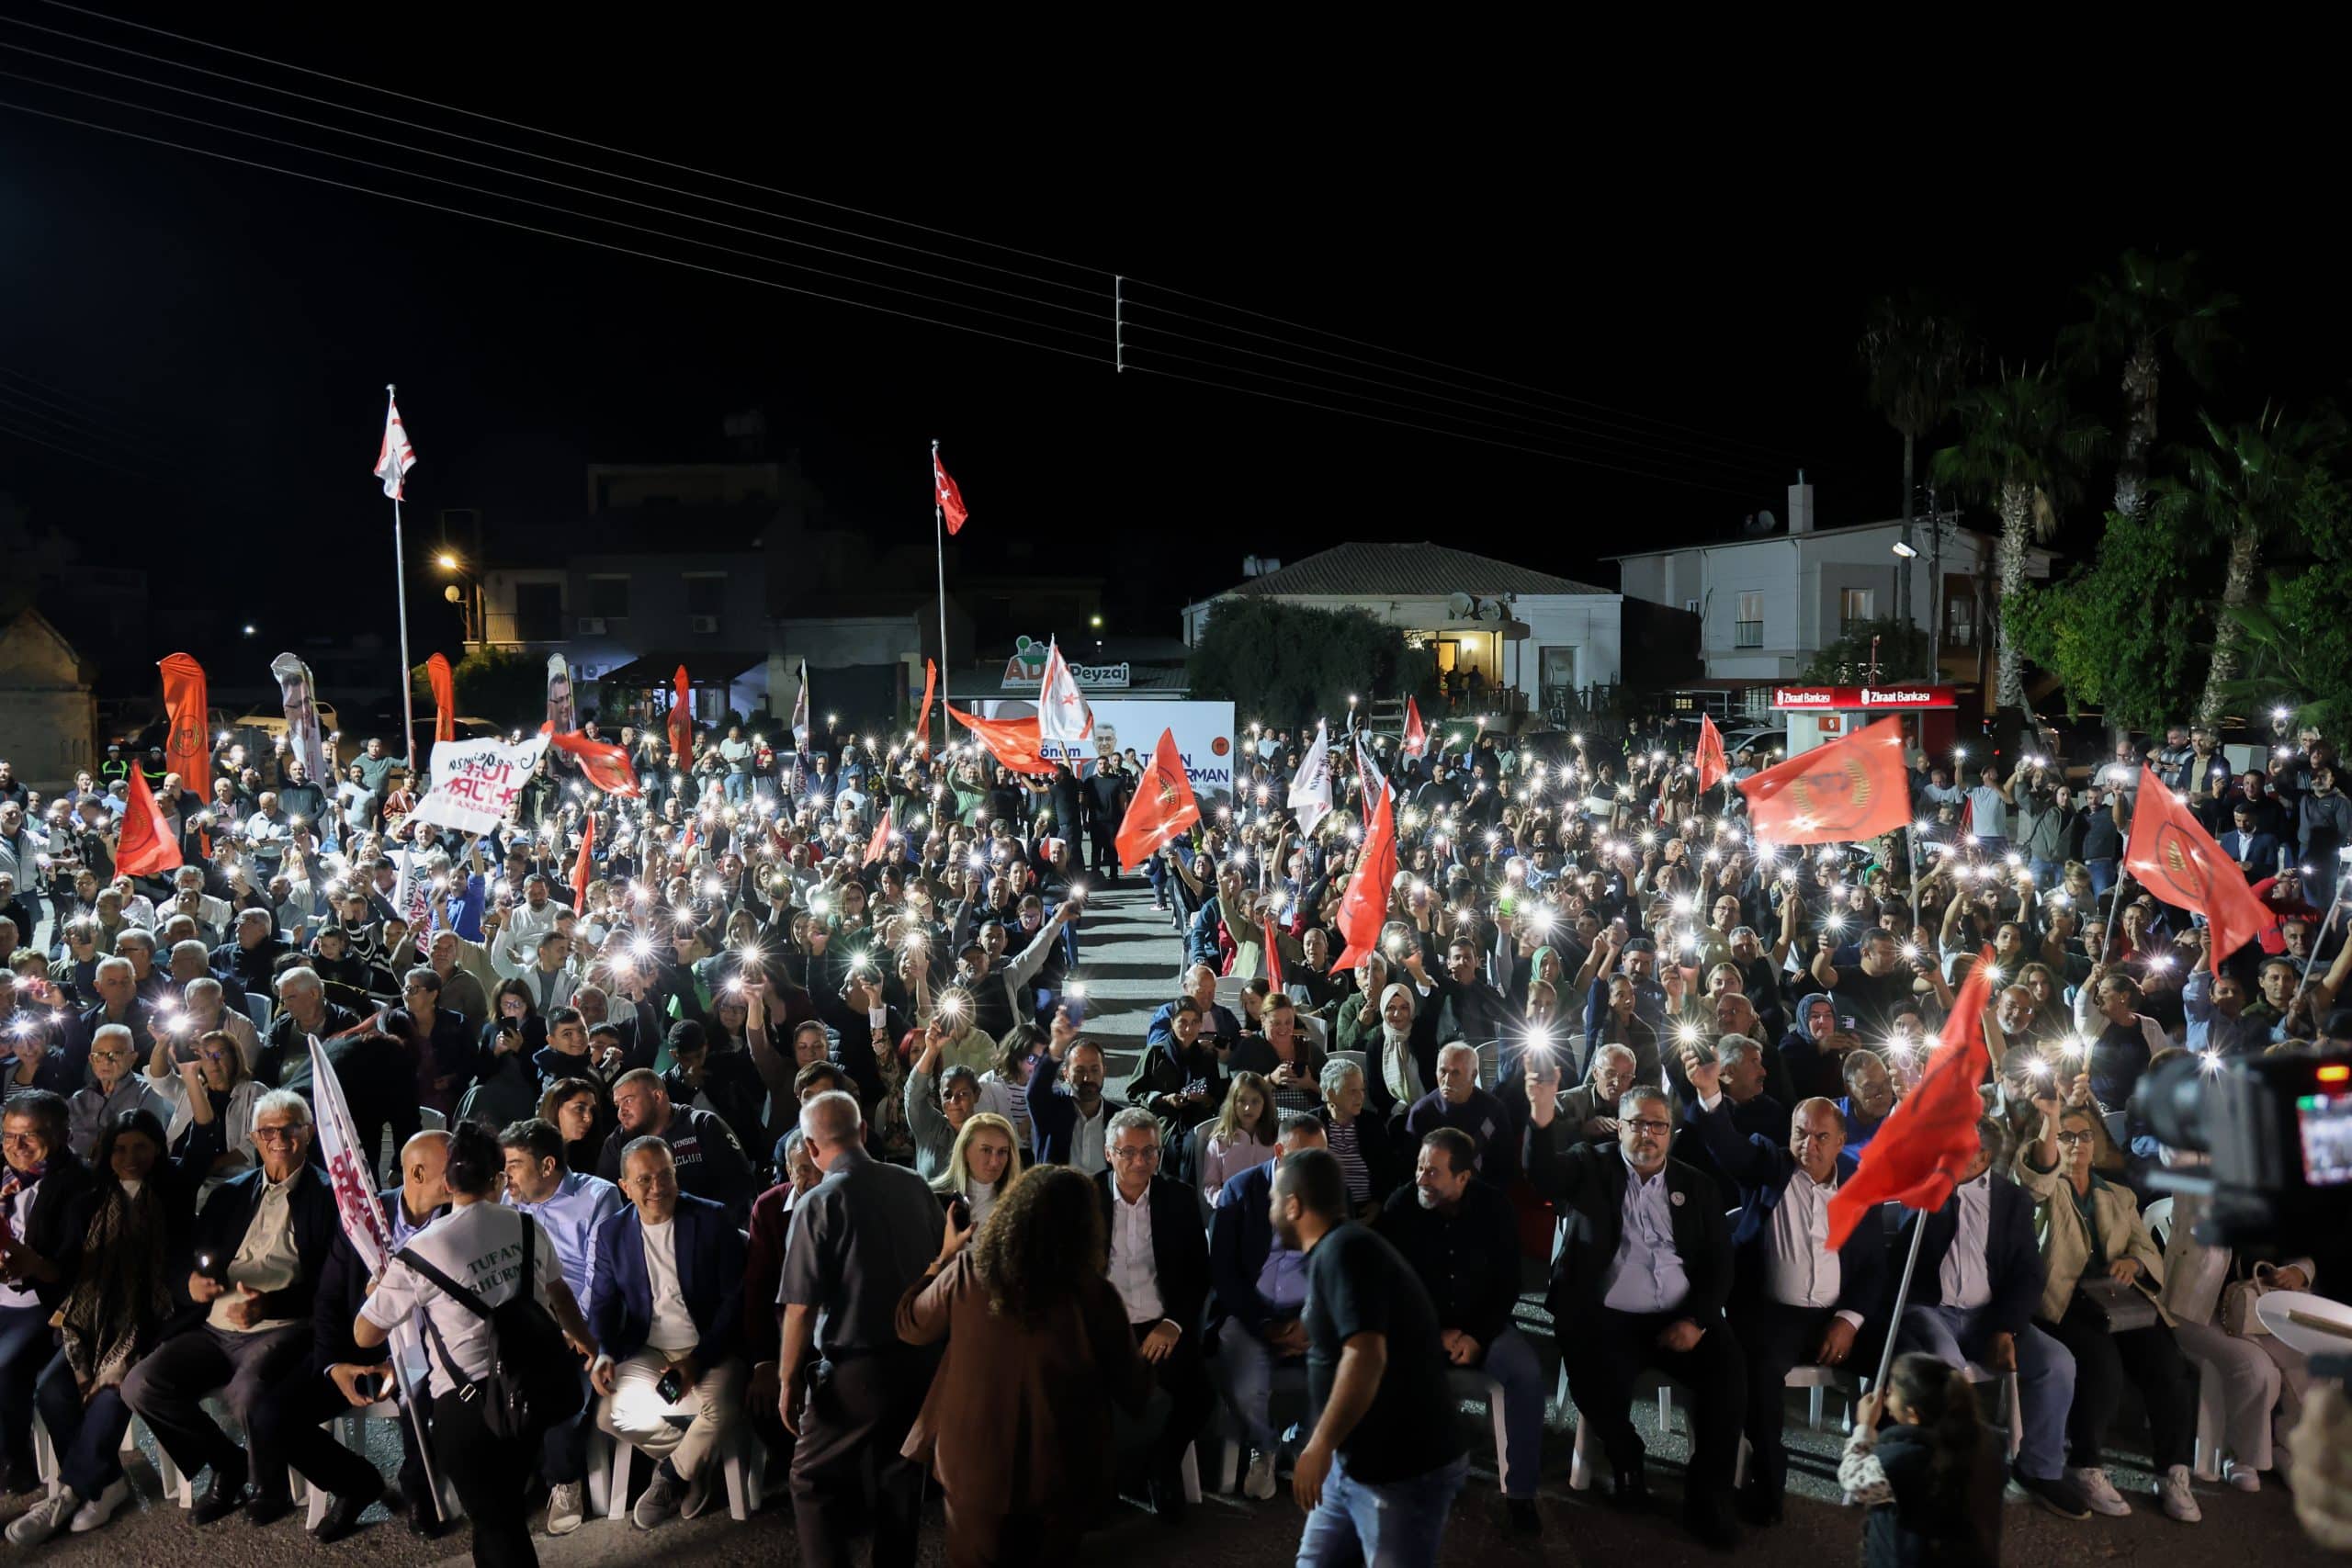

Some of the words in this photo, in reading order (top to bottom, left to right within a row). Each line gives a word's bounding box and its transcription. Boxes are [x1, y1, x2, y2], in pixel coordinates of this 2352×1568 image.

[1071, 663, 1128, 682] Peyzaj
[1784, 693, 1804, 704] Ziraat
[1804, 692, 1830, 703] Bankası
[1871, 691, 1897, 703] Ziraat
[1897, 691, 1930, 702] Bankası
[467, 1242, 523, 1275] TUFAN
